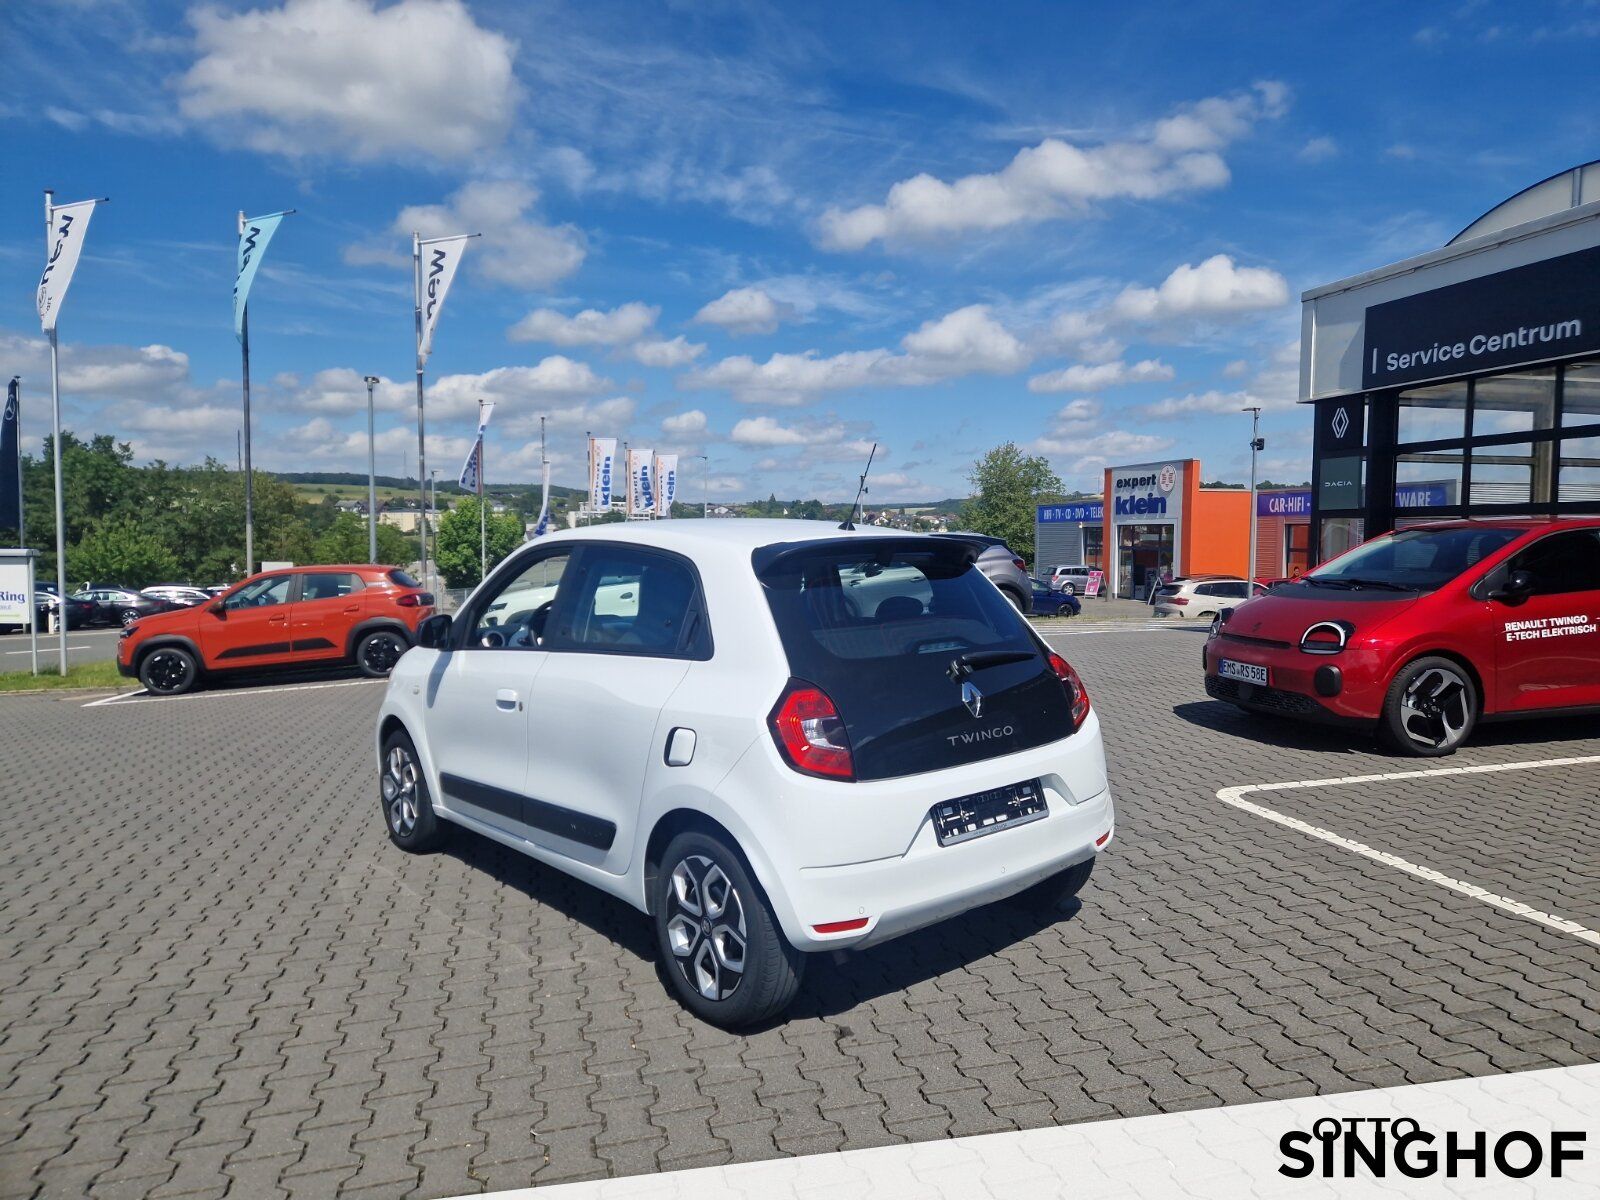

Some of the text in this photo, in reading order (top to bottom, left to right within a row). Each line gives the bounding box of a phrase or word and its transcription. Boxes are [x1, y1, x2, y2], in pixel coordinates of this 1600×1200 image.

[1386, 318, 1581, 371] Service Centrum
[601, 456, 611, 506] klein
[640, 465, 653, 508] klein
[1116, 473, 1157, 489] expert
[1115, 493, 1167, 515] klein
[1269, 497, 1305, 513] CAR-HIFI
[1504, 614, 1588, 632] RENAULT TWINGO
[1506, 624, 1597, 642] E-TECH ELEKTRISCH
[1240, 664, 1250, 678] RS
[1251, 667, 1266, 682] 58E
[946, 725, 1014, 746] TWINGO
